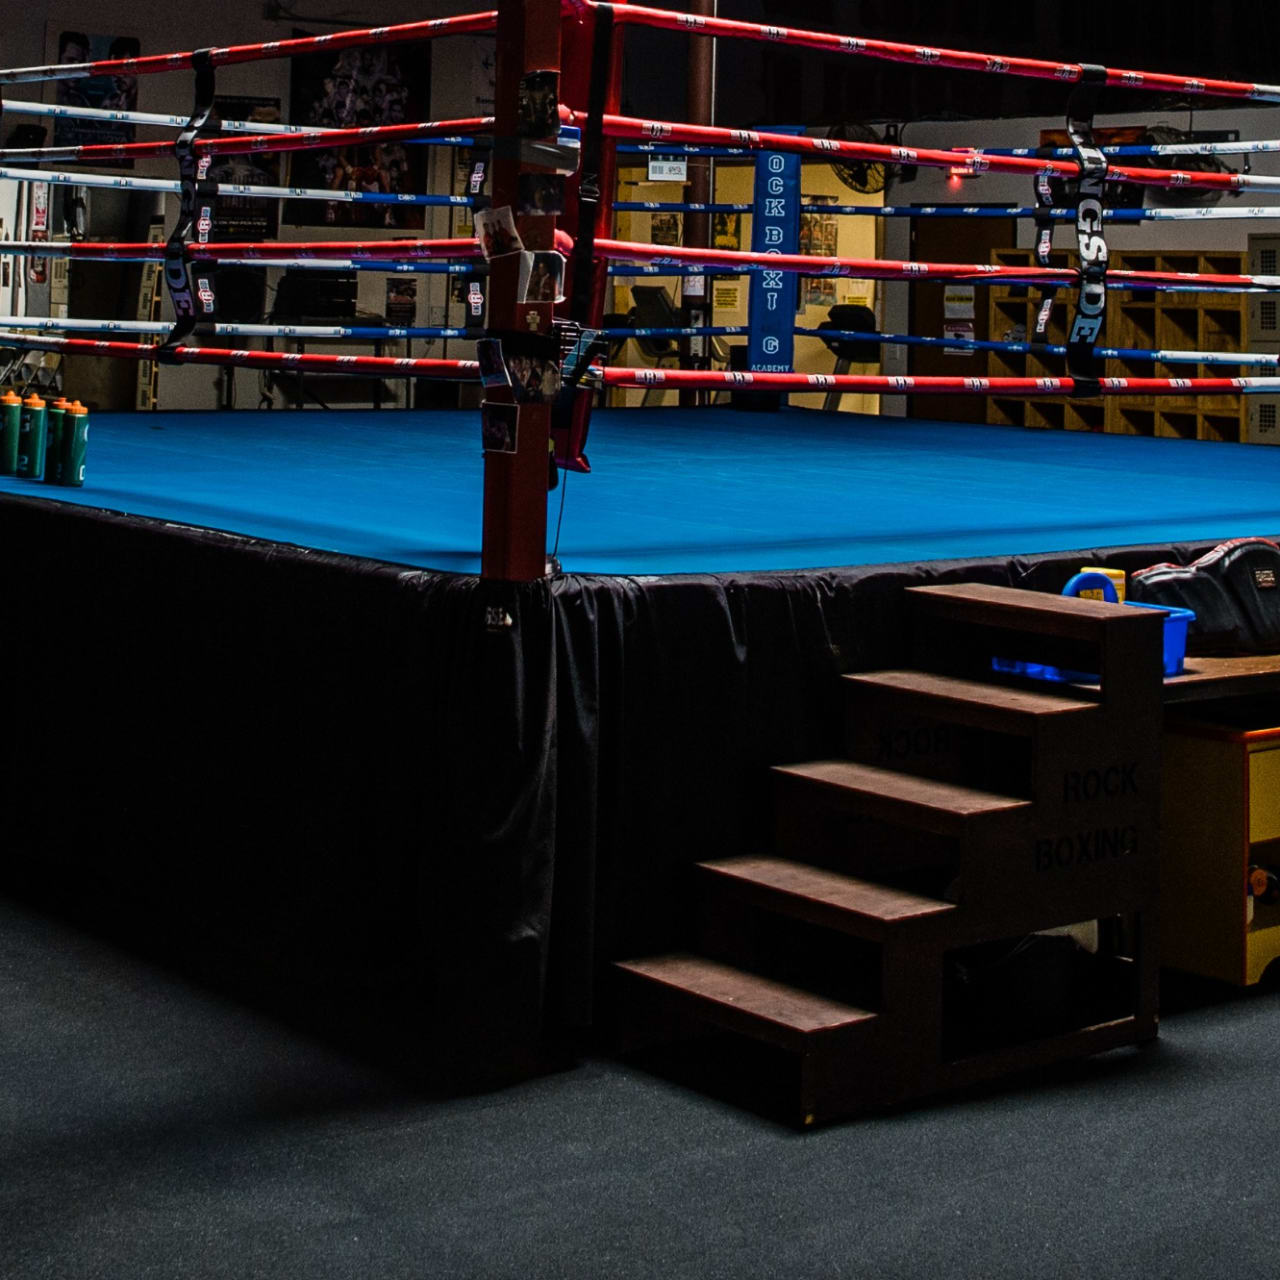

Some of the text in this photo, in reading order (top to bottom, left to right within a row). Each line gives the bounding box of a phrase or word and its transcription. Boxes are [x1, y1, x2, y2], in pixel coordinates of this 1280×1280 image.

[764, 154, 786, 217] OCK
[762, 226, 784, 355] BXIG
[1063, 762, 1138, 803] ROCK
[1034, 825, 1138, 873] BOXING
